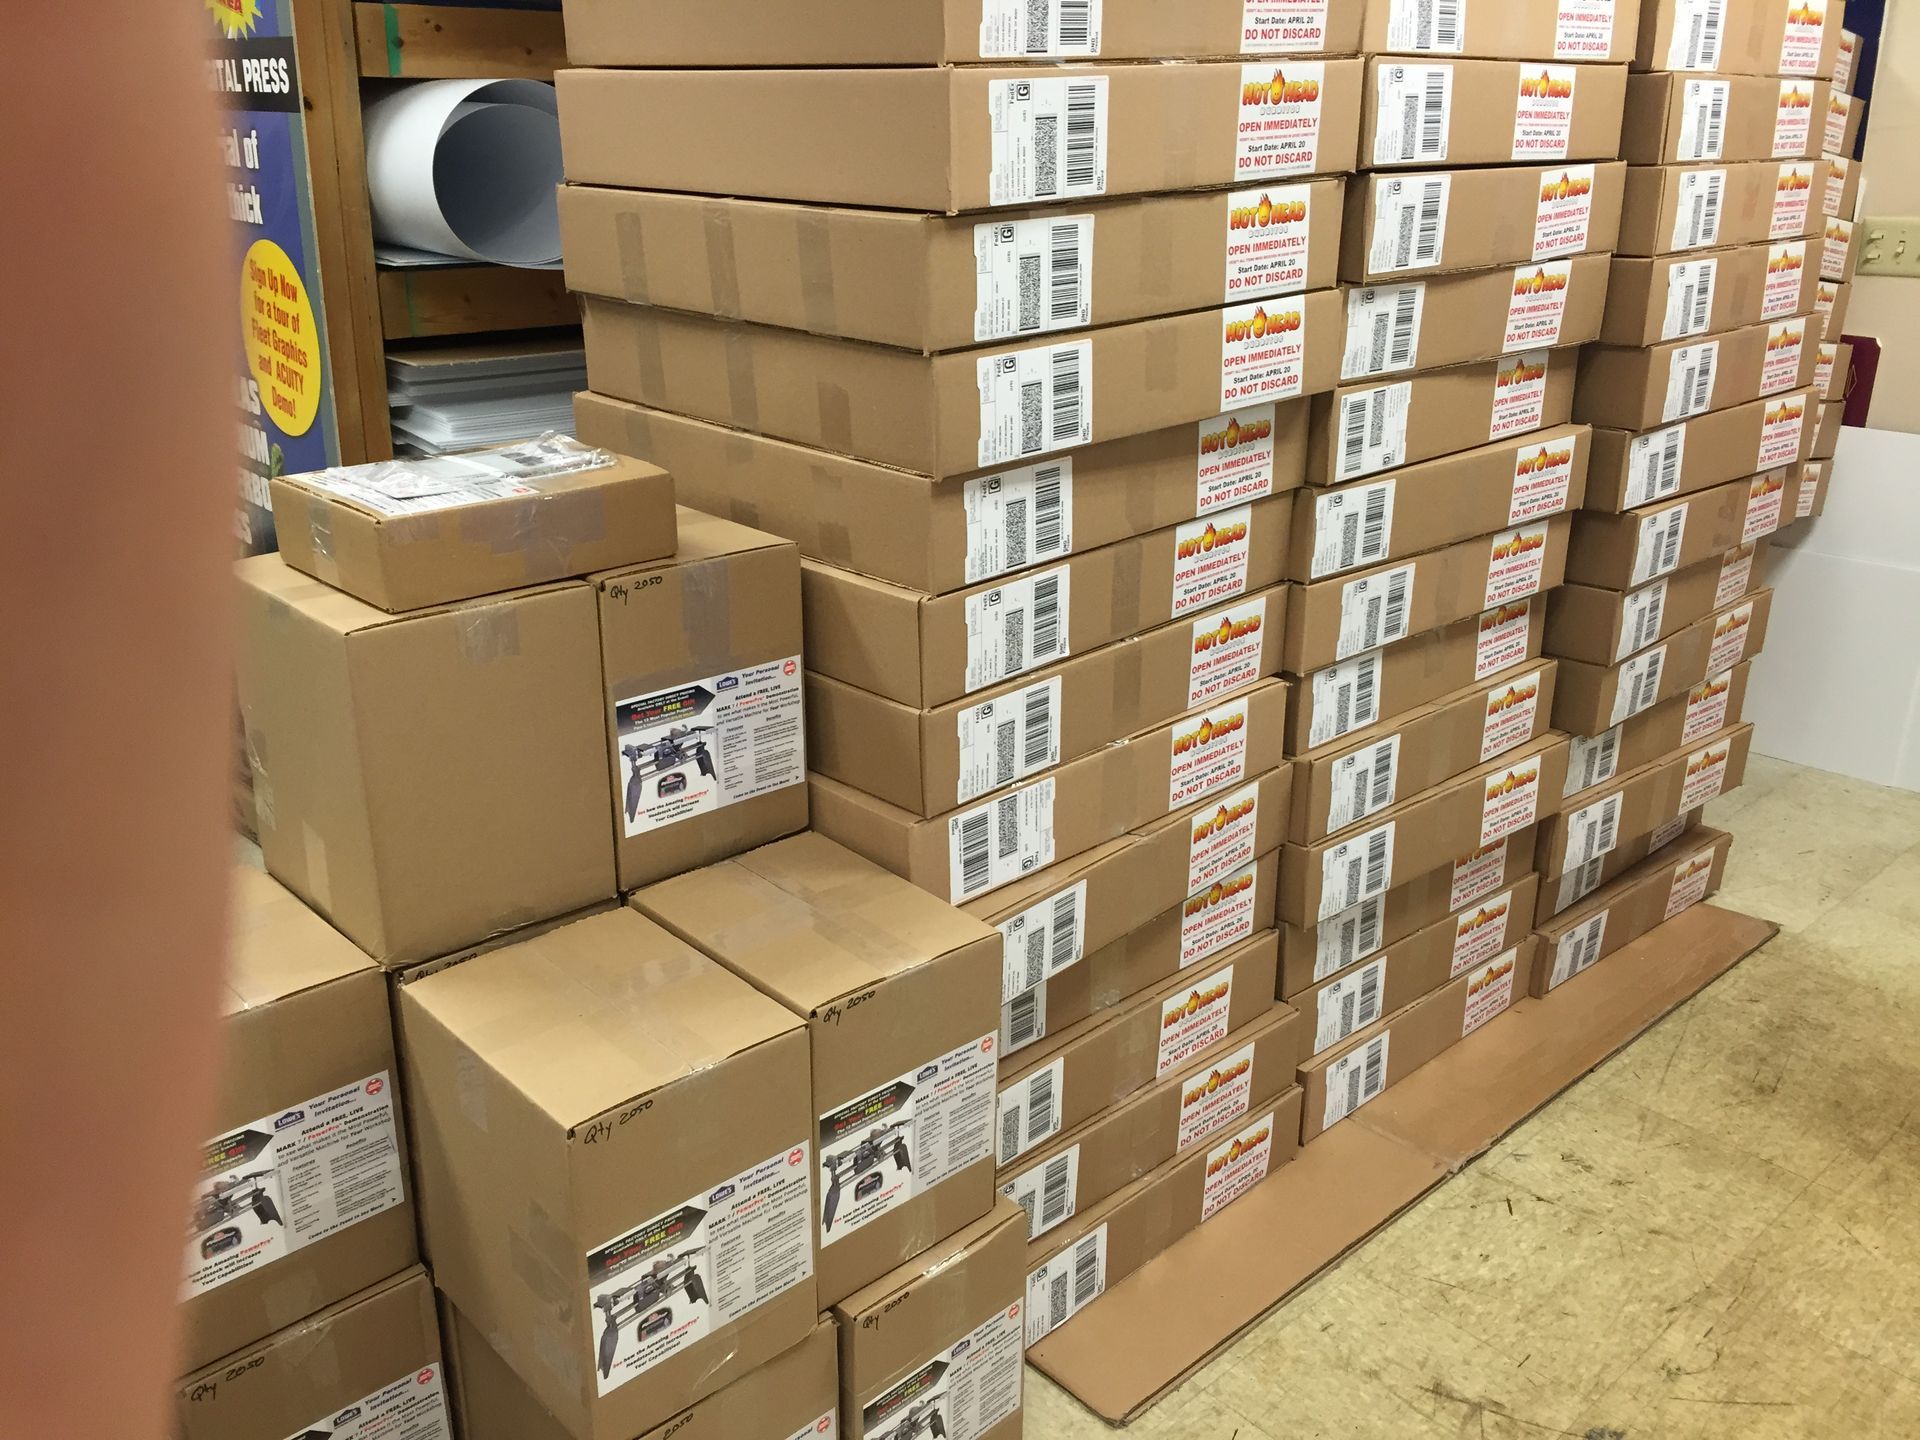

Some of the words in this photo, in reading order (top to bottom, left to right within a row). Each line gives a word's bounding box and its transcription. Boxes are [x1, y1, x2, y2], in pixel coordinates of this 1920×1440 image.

[1287, 16, 1305, 24] APRIL
[1306, 16, 1314, 24] 20
[1245, 29, 1258, 40] DO
[1261, 28, 1280, 39] NOT
[1282, 28, 1321, 39] DISCARD
[242, 57, 290, 94] PRESS
[1018, 86, 1029, 97] G
[1242, 81, 1270, 105] HOT
[1283, 79, 1319, 103] HEAD
[1520, 77, 1540, 97] HOT
[1547, 79, 1572, 98] HEAD
[1239, 121, 1261, 132] OPEN
[1263, 117, 1317, 130] IMMEDIATELY
[1517, 110, 1532, 118] OPEN
[1533, 111, 1569, 119] IMMEDIATELY
[243, 129, 260, 169] of
[1248, 144, 1262, 152] Start
[1264, 143, 1278, 151] Date:
[1280, 141, 1296, 149] APRIL
[1515, 139, 1524, 147] DO
[1525, 139, 1538, 147] NOT
[1539, 139, 1565, 147] DISCARD
[1238, 156, 1251, 167] DO
[1254, 154, 1272, 166] NOT
[1275, 150, 1312, 164] DISCARD
[1230, 205, 1257, 230] HOT
[1271, 199, 1306, 224] HEAD
[1002, 229, 1013, 239] G
[1228, 243, 1250, 255] OPEN
[1252, 235, 1306, 252] IMMEDIATELY
[1238, 265, 1252, 273] Start
[1254, 262, 1267, 271] Date:
[1270, 259, 1286, 268] APRIL
[250, 259, 267, 289] Sign
[267, 269, 279, 297] Up
[280, 273, 298, 302] Now
[1229, 277, 1241, 289] DO
[1244, 274, 1262, 286] NOT
[1266, 267, 1303, 282] DISCARD
[254, 291, 265, 316] for
[266, 302, 273, 319] a
[273, 301, 289, 329] tour
[291, 312, 300, 335] of
[1225, 318, 1252, 343] HOT
[1266, 309, 1301, 335] HEAD
[252, 318, 271, 348] Fleet
[272, 330, 308, 368] Graphics
[1004, 360, 1014, 369] G
[1224, 355, 1245, 367] OPEN
[1248, 343, 1301, 362] IMMEDIATELY
[258, 354, 272, 377] and
[276, 361, 304, 395] ACUITY
[1225, 387, 1237, 399] DO
[1240, 382, 1258, 395] NOT
[1261, 373, 1298, 390] DISCARD
[1233, 375, 1247, 384] Start
[1249, 371, 1263, 380] Date:
[1265, 367, 1281, 377] APRIL
[1283, 365, 1290, 373] 20
[271, 386, 297, 419] Demo!
[1516, 456, 1537, 476] HOT
[1545, 447, 1571, 468] HEAD
[1513, 484, 1529, 494] OPEN
[1530, 473, 1568, 490] IMMEDIATELY
[1511, 509, 1520, 518] DO
[1522, 505, 1535, 515] NOT
[1537, 497, 1563, 511] DISCARD
[1177, 534, 1203, 560] HOT
[1214, 520, 1247, 548] HEAD
[1175, 568, 1195, 582] OPEN
[1197, 550, 1246, 574] IMMEDIATELY
[610, 585, 628, 606] Qty
[634, 576, 663, 590] 2050
[1175, 597, 1186, 609] DO
[1189, 590, 1206, 604] NOT
[1208, 577, 1242, 597] DISCARD
[742, 670, 754, 678] Your
[755, 664, 779, 674] Personal
[719, 678, 735, 688] LOWE'S
[663, 701, 681, 712] FREE
[716, 704, 730, 712] MARK
[1173, 729, 1199, 756] HOT
[1211, 710, 1244, 740] HEAD
[1171, 761, 1191, 776] OPEN
[1194, 738, 1244, 766] IMMEDIATELY
[1172, 789, 1183, 801] DO
[1186, 780, 1203, 795] NOT
[1206, 763, 1241, 786] DISCARD
[846, 990, 876, 1010] 2050
[1163, 1001, 1187, 1029] HOT
[1198, 979, 1229, 1010] HEAD
[1161, 1031, 1179, 1047] OPEN
[1181, 1003, 1227, 1035] IMMEDIATELY
[1160, 1057, 1171, 1070] DO
[1173, 1047, 1189, 1062] NOT
[1191, 1027, 1224, 1052] DISCARD
[308, 1099, 326, 1110] Your
[327, 1086, 360, 1102] Personal
[349, 1106, 364, 1116] LIVE
[584, 1121, 612, 1144] Qty
[619, 1099, 653, 1125] 2050
[739, 1171, 753, 1183] Your
[755, 1156, 783, 1175] Personal
[712, 1185, 731, 1202] LOWE'S
[731, 1195, 751, 1210] Attend
[773, 1178, 785, 1188] LIVE
[708, 1216, 725, 1229] MARK
[644, 1229, 666, 1247] FREE
[884, 1291, 910, 1313] 2050
[623, 1352, 634, 1362] how
[636, 1347, 645, 1355] the
[646, 1333, 668, 1350] Amazing
[655, 1343, 664, 1351] will
[635, 1359, 646, 1369] Your
[190, 1382, 217, 1402] Qty
[226, 1356, 265, 1382] 2050
[382, 1378, 412, 1396] Personal
[662, 1413, 694, 1440] 2050
